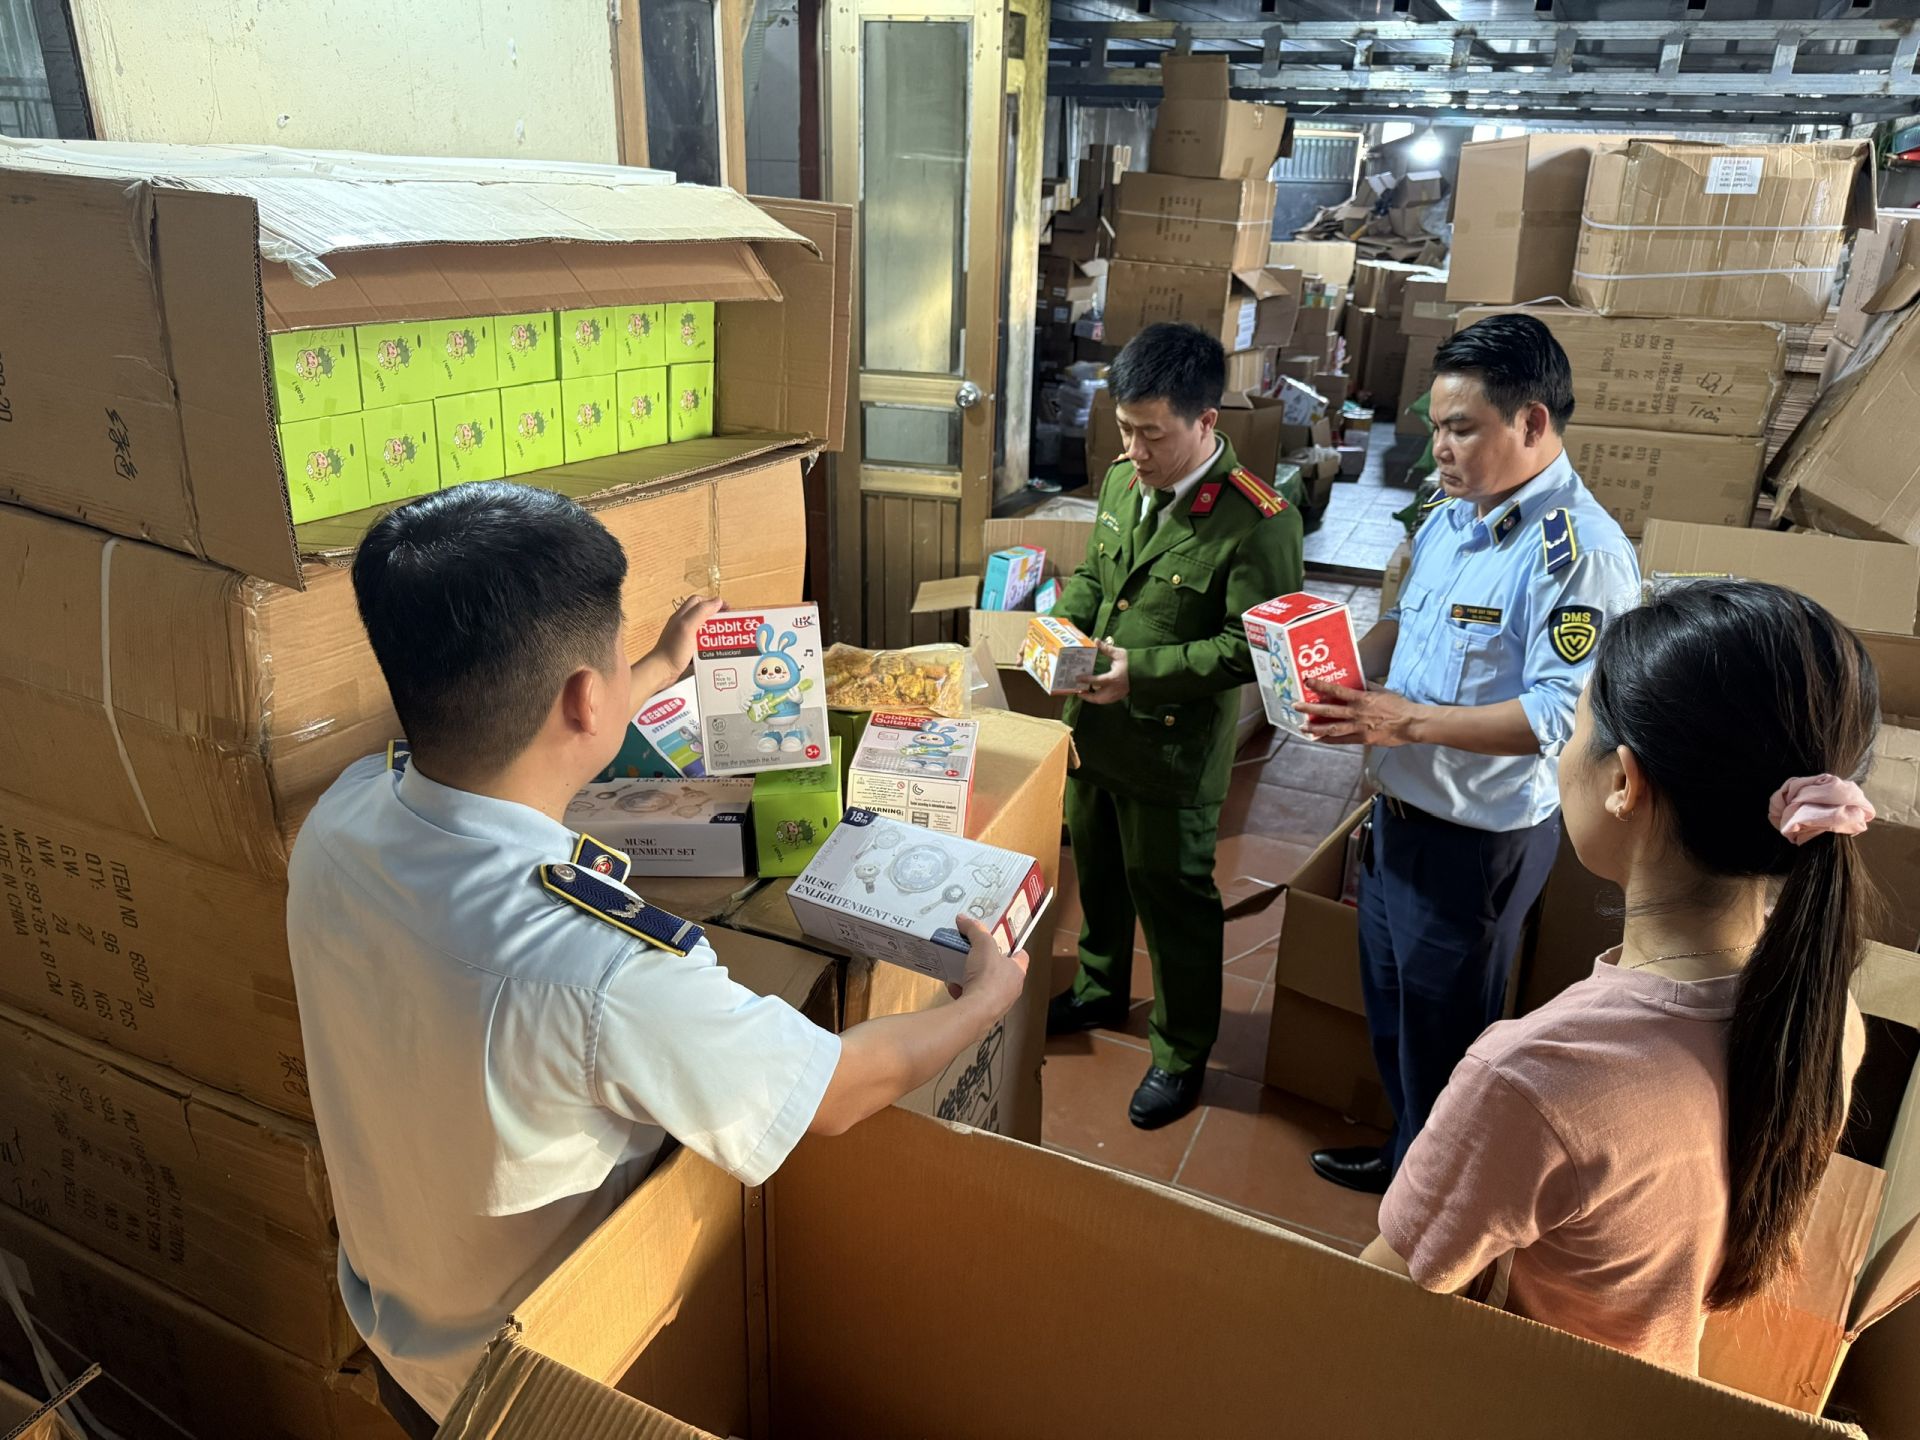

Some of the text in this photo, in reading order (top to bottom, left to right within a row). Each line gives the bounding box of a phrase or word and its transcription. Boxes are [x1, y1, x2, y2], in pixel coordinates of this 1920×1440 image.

[1562, 612, 1591, 623] DMS
[699, 622, 741, 635] Rabbit
[700, 633, 756, 647] Guitarist
[1301, 661, 1336, 681] Rabbit
[625, 838, 656, 847] MUSIC
[2, 872, 19, 890] IN
[802, 874, 838, 892] MUSIC
[7, 892, 29, 936] CHINA
[794, 883, 915, 928] ENLIGHTENMENT SET
[110, 860, 134, 902] ITEM
[129, 951, 154, 1009] 690-20
[52, 912, 71, 935] 24
[69, 979, 88, 1011] KGS
[77, 923, 96, 946] 27
[93, 989, 113, 1021] KGS
[102, 930, 120, 954] 96
[118, 998, 137, 1030] PCS
